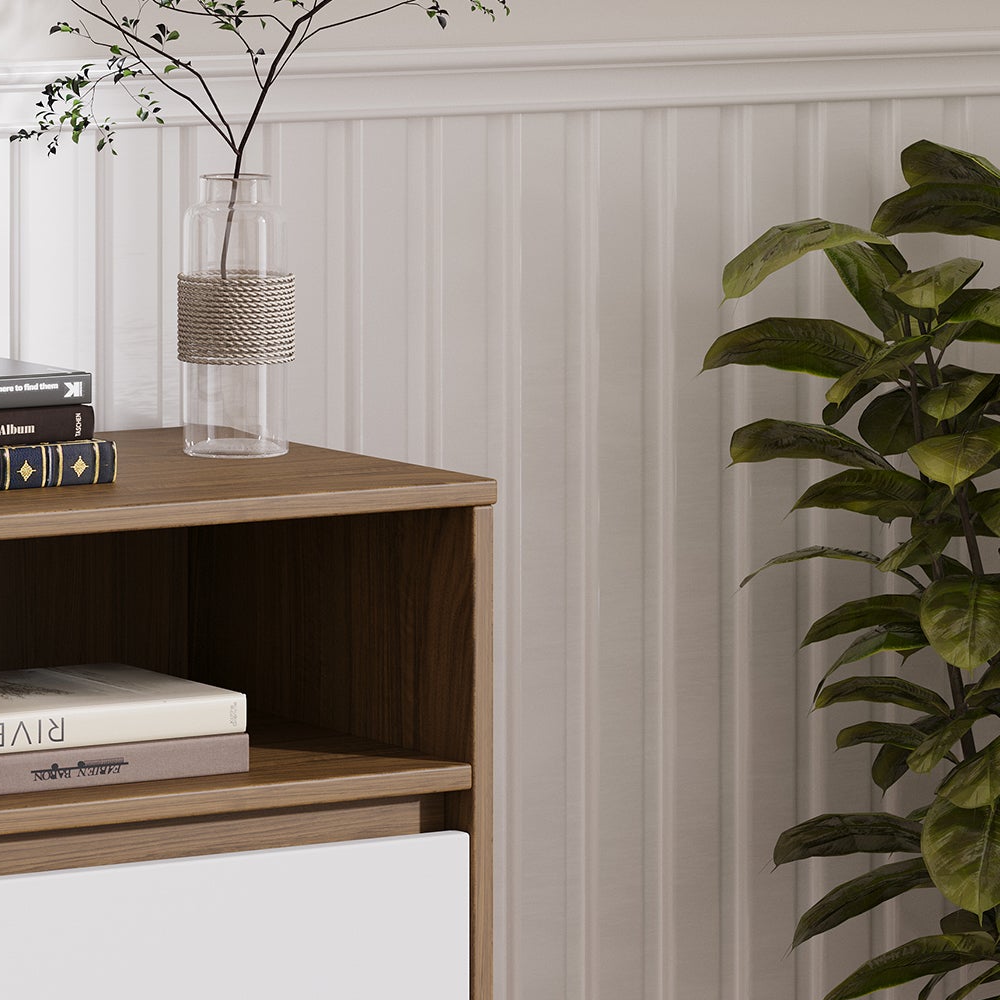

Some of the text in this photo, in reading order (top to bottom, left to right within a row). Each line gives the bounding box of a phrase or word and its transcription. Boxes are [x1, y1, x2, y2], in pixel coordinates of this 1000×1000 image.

[23, 383, 39, 391] find
[39, 382, 59, 390] them
[0, 424, 35, 436] Album
[74, 412, 83, 438] TASCHEN
